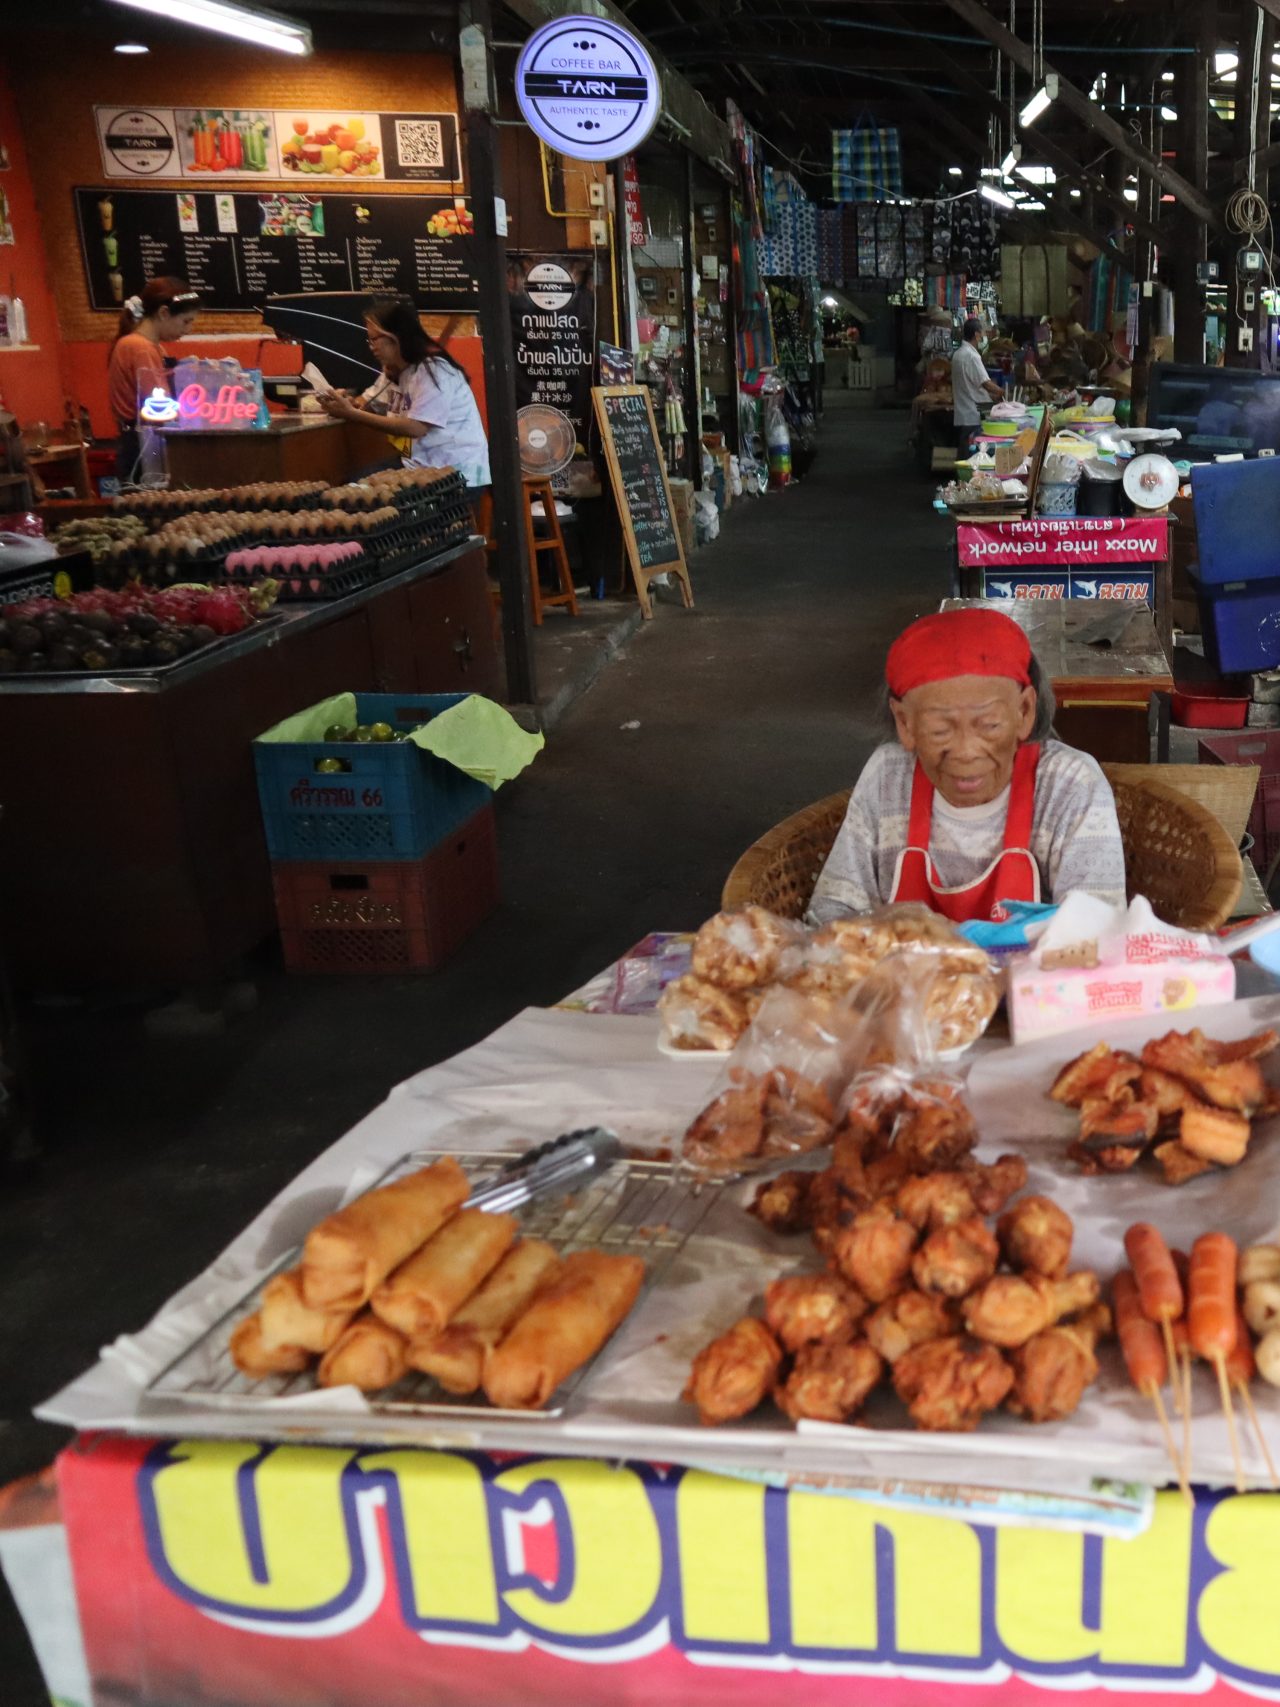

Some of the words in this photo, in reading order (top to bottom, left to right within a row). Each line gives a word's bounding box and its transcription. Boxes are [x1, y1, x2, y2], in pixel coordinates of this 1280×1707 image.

[551, 57, 594, 70] COFFEE
[598, 60, 622, 71] BAR
[557, 79, 616, 96] TARN
[550, 105, 599, 116] AUTHENTIC
[602, 108, 629, 117] TASTE
[536, 283, 563, 291] TARN
[522, 311, 579, 329] กาแฟสด
[527, 328, 549, 340] เริ่มต้น
[552, 331, 562, 340] 25
[564, 332, 579, 341] บาท
[517, 341, 593, 366] น้ำผลไม้ปั่น
[552, 368, 563, 376] 35
[564, 368, 580, 376] บาท
[178, 383, 259, 425] Coffee
[604, 395, 647, 416] SPECIAL
[968, 541, 1047, 559] network
[1053, 539, 1099, 556] inter
[1105, 538, 1158, 553] Maxx
[1098, 583, 1149, 600] ฉลาม
[361, 787, 383, 808] 66
